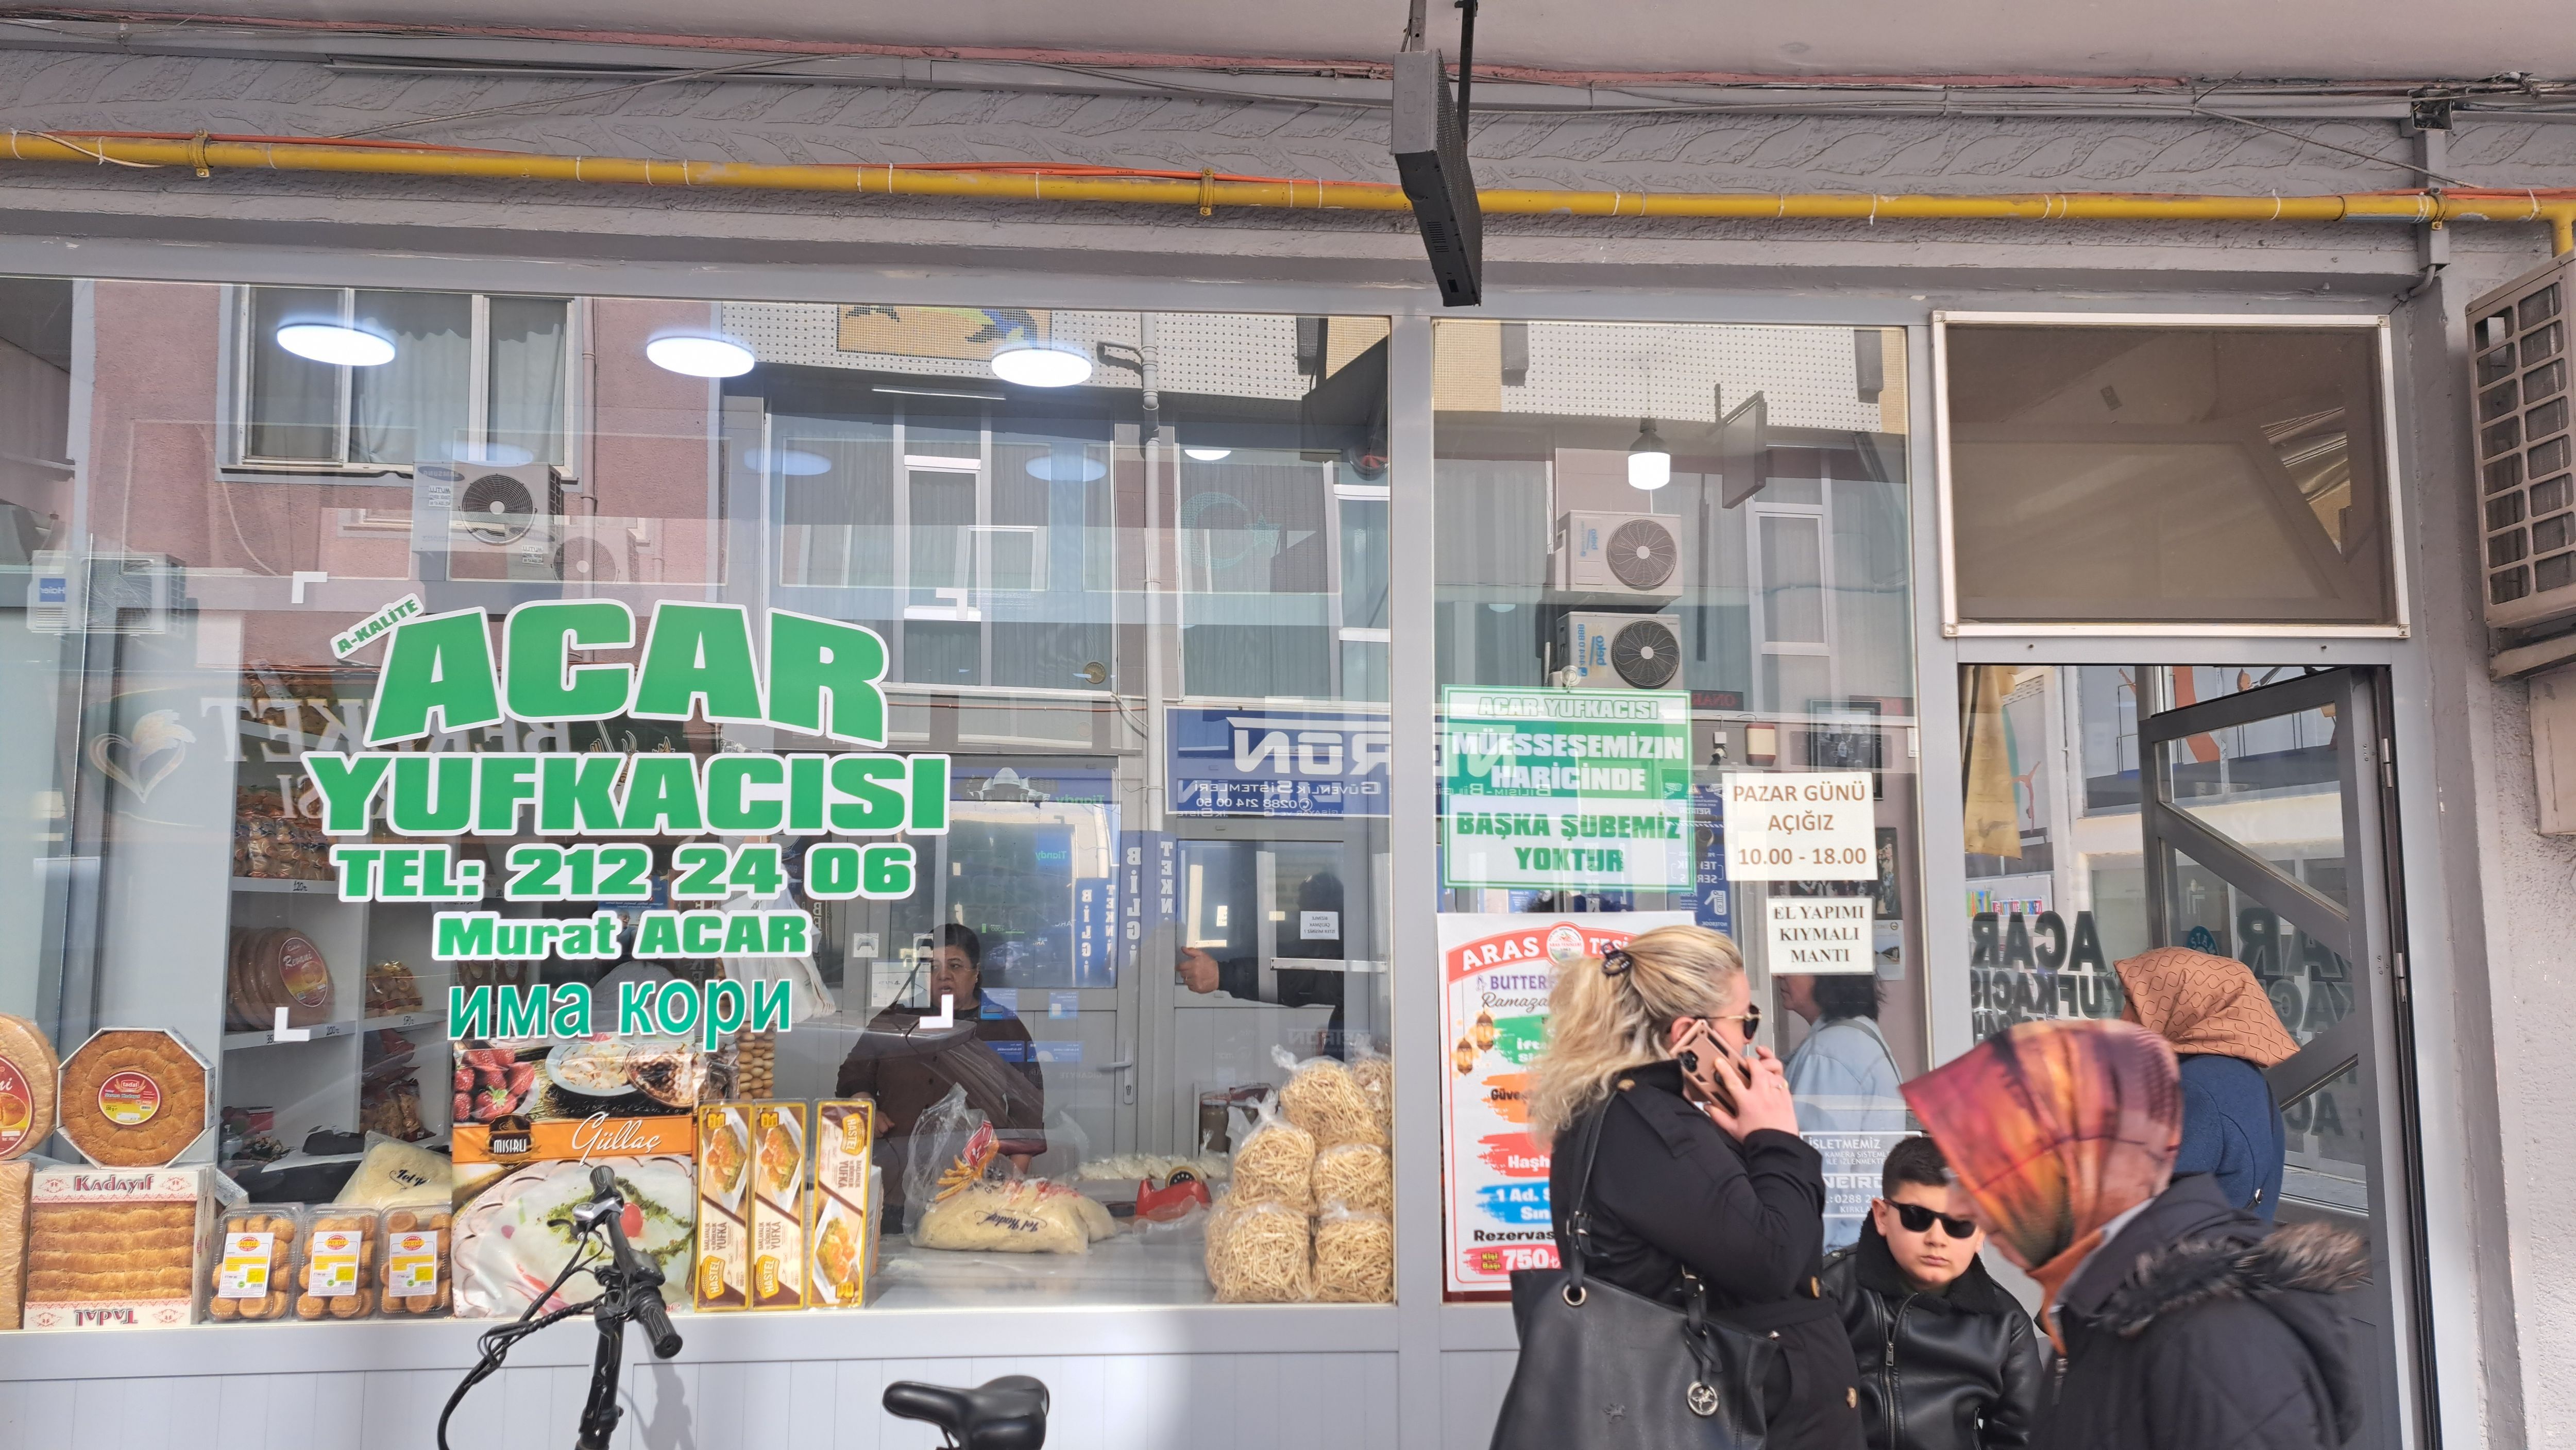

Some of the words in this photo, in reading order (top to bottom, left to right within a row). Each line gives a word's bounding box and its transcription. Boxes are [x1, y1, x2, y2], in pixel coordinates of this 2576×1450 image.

[336, 597, 419, 653] A-KALİTE
[369, 601, 886, 744] ACAR
[1478, 697, 1538, 716] ACAR
[1544, 698, 1658, 720] YUFKACISI
[1490, 762, 1646, 792] HARİCİNDE
[1733, 785, 1797, 802] PAZAR
[1804, 781, 1866, 802] GÜNÜ
[306, 756, 946, 832] YUFKACISI
[1456, 813, 1547, 841] BAŞKA
[1561, 811, 1681, 841] ŞUBEMİZ
[1768, 810, 1834, 835] AÇIĞIZ
[1514, 846, 1623, 873] YOKTUR
[1739, 848, 1793, 865] 10.00
[1812, 847, 1867, 865] 18.00
[336, 849, 480, 897] TEL:
[512, 848, 649, 896] 212
[677, 848, 783, 895] 24
[811, 847, 912, 894] 06
[1773, 906, 1795, 920] EL
[1800, 905, 1865, 920] YAPIMI
[437, 916, 617, 956] Murat
[637, 915, 806, 954] ACAR
[1780, 928, 1860, 942] KIYMALI
[1462, 936, 1541, 971] ARAS
[1791, 949, 1850, 963] MANTI
[1490, 975, 1548, 990] BUTTER
[448, 981, 593, 1040] има
[618, 978, 793, 1052] кори
[571, 1110, 663, 1167] Güllaç
[845, 1118, 857, 1151] HASTEL
[838, 1160, 849, 1188] YUFKA
[1496, 1189, 1505, 1202] 1
[1510, 1188, 1539, 1202] Ad.
[1834, 1194, 1862, 1204] 0288
[717, 1222, 727, 1251] YUFKA
[771, 1221, 781, 1250] YUFKA
[709, 1260, 721, 1294] HASTEL
[763, 1260, 775, 1293] HASTEL
